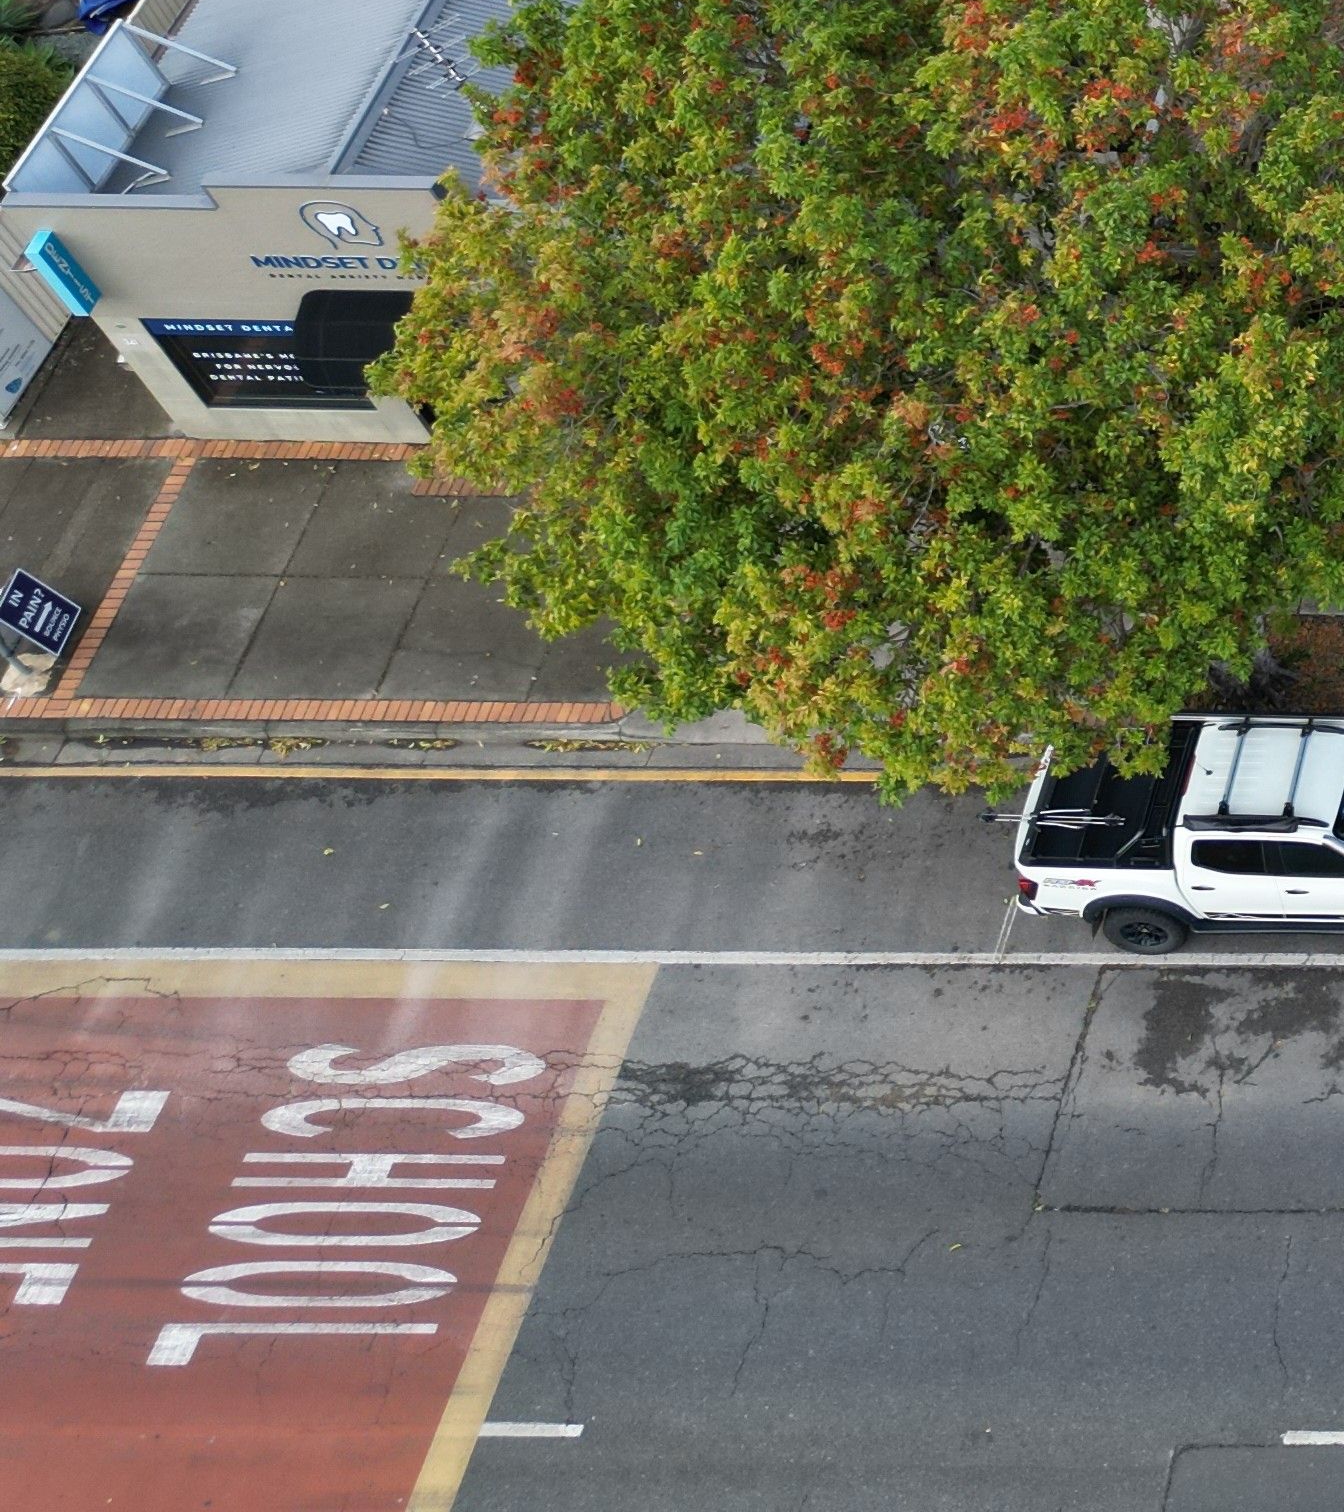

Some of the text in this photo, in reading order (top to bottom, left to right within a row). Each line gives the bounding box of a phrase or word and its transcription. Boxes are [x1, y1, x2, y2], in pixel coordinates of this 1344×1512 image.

[250, 255, 369, 269] MINDSET
[240, 324, 294, 332] DENTA
[8, 589, 24, 607] IN
[18, 588, 45, 629] PAIN?
[146, 1043, 546, 1366] SCHOOL
